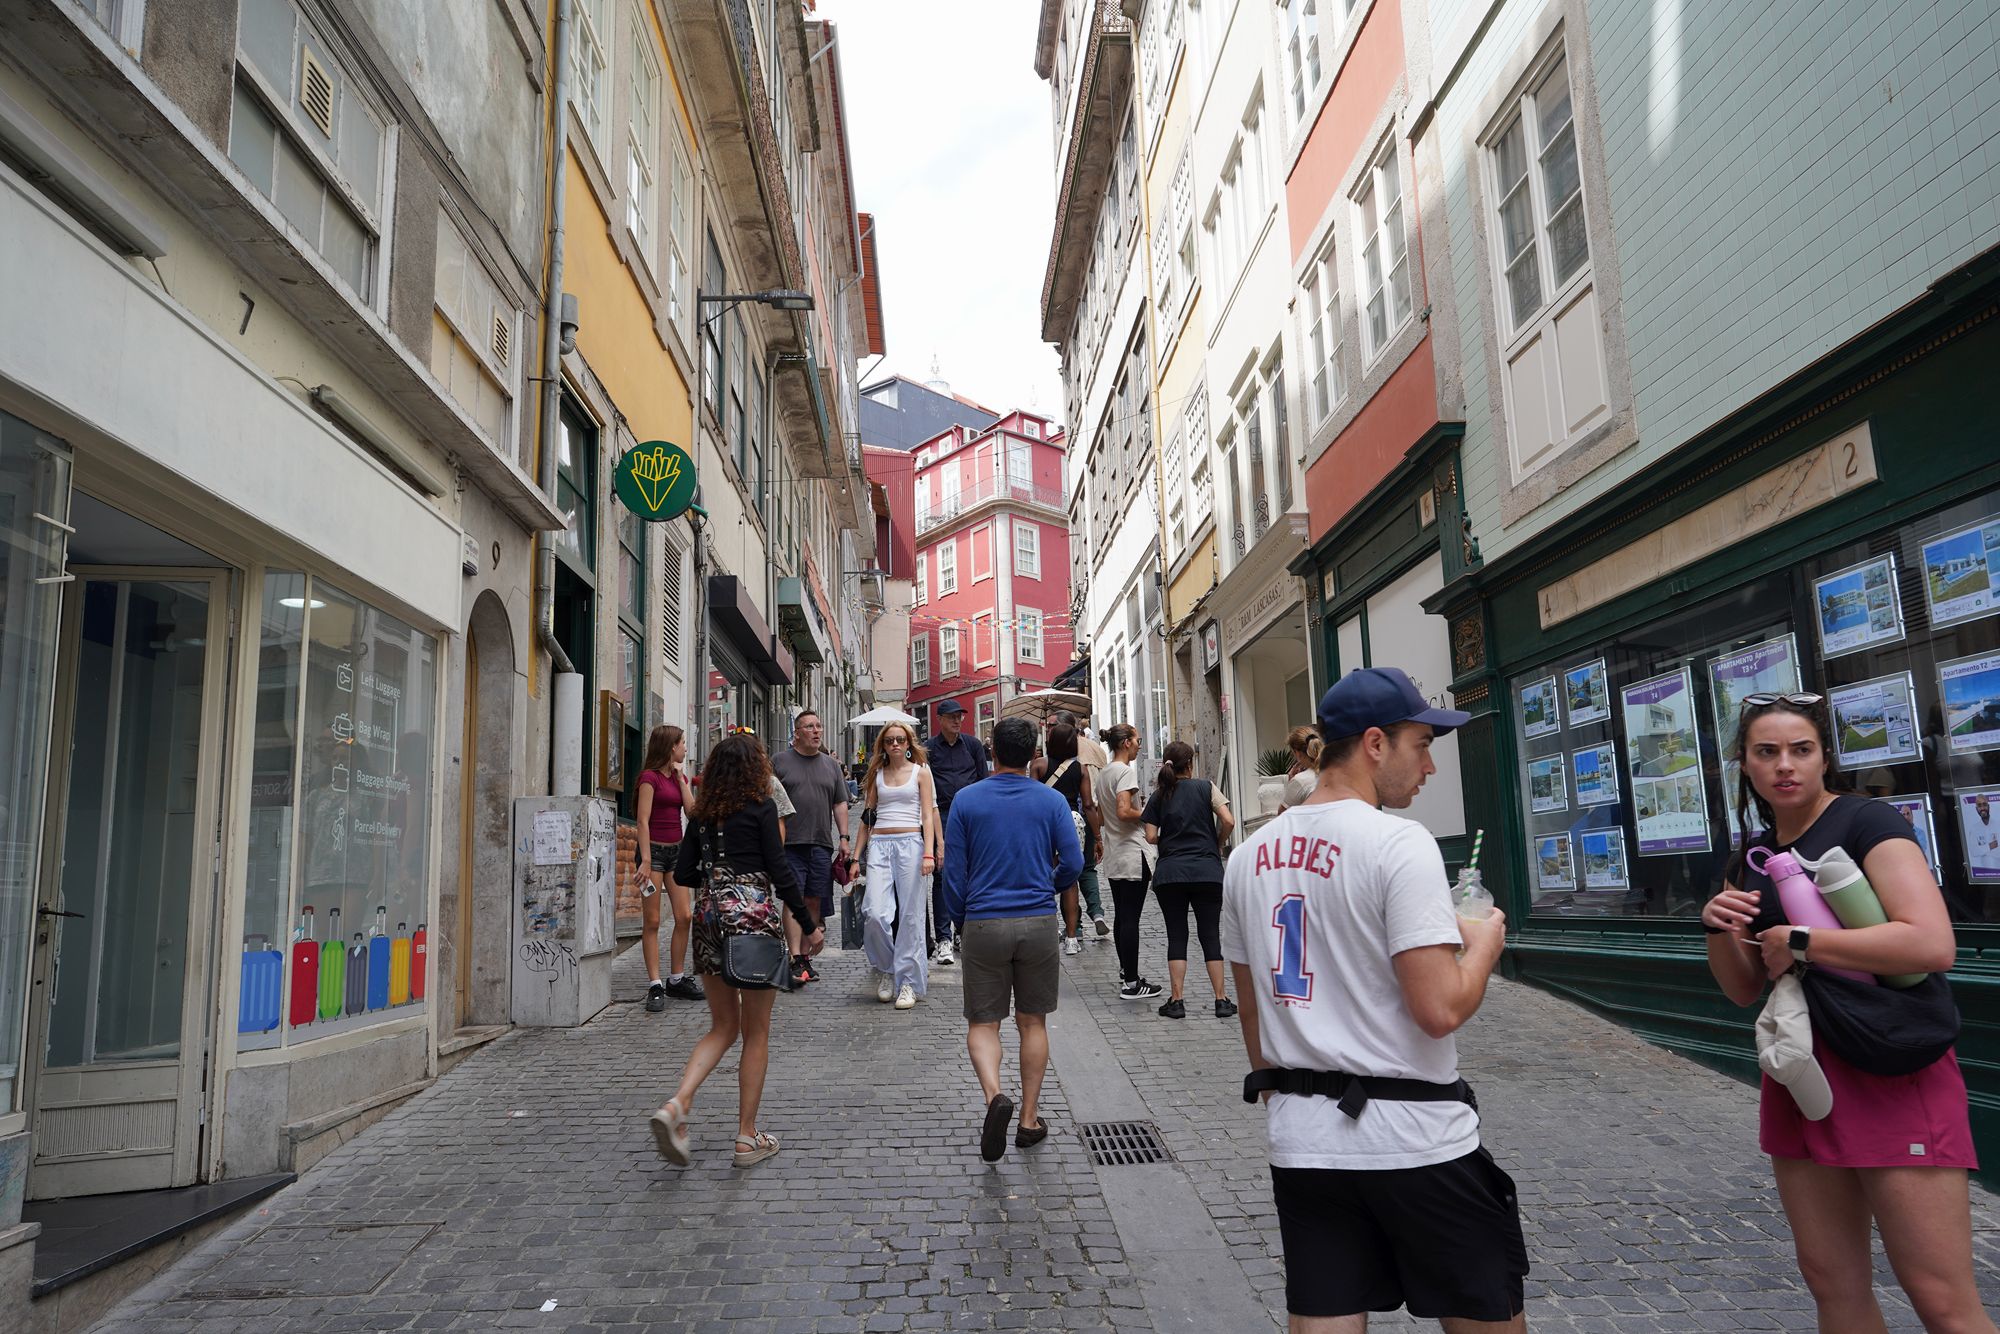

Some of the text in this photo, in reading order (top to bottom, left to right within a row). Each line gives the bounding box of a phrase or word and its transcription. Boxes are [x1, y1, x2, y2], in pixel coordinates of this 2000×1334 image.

[239, 290, 255, 336] 7
[1843, 442, 1858, 479] 2
[492, 540, 501, 571] 9
[1545, 593, 1552, 618] 4
[1717, 655, 1753, 672] APARTAMENTO
[1943, 664, 1980, 677] Apartamento
[361, 672, 401, 699] Left Luggage
[359, 720, 391, 742] Bag Wrap
[356, 770, 384, 789] Baggage
[354, 818, 402, 839] Parcel Delivery
[1255, 835, 1341, 879] ALBIES
[1271, 893, 1314, 1001] 1
